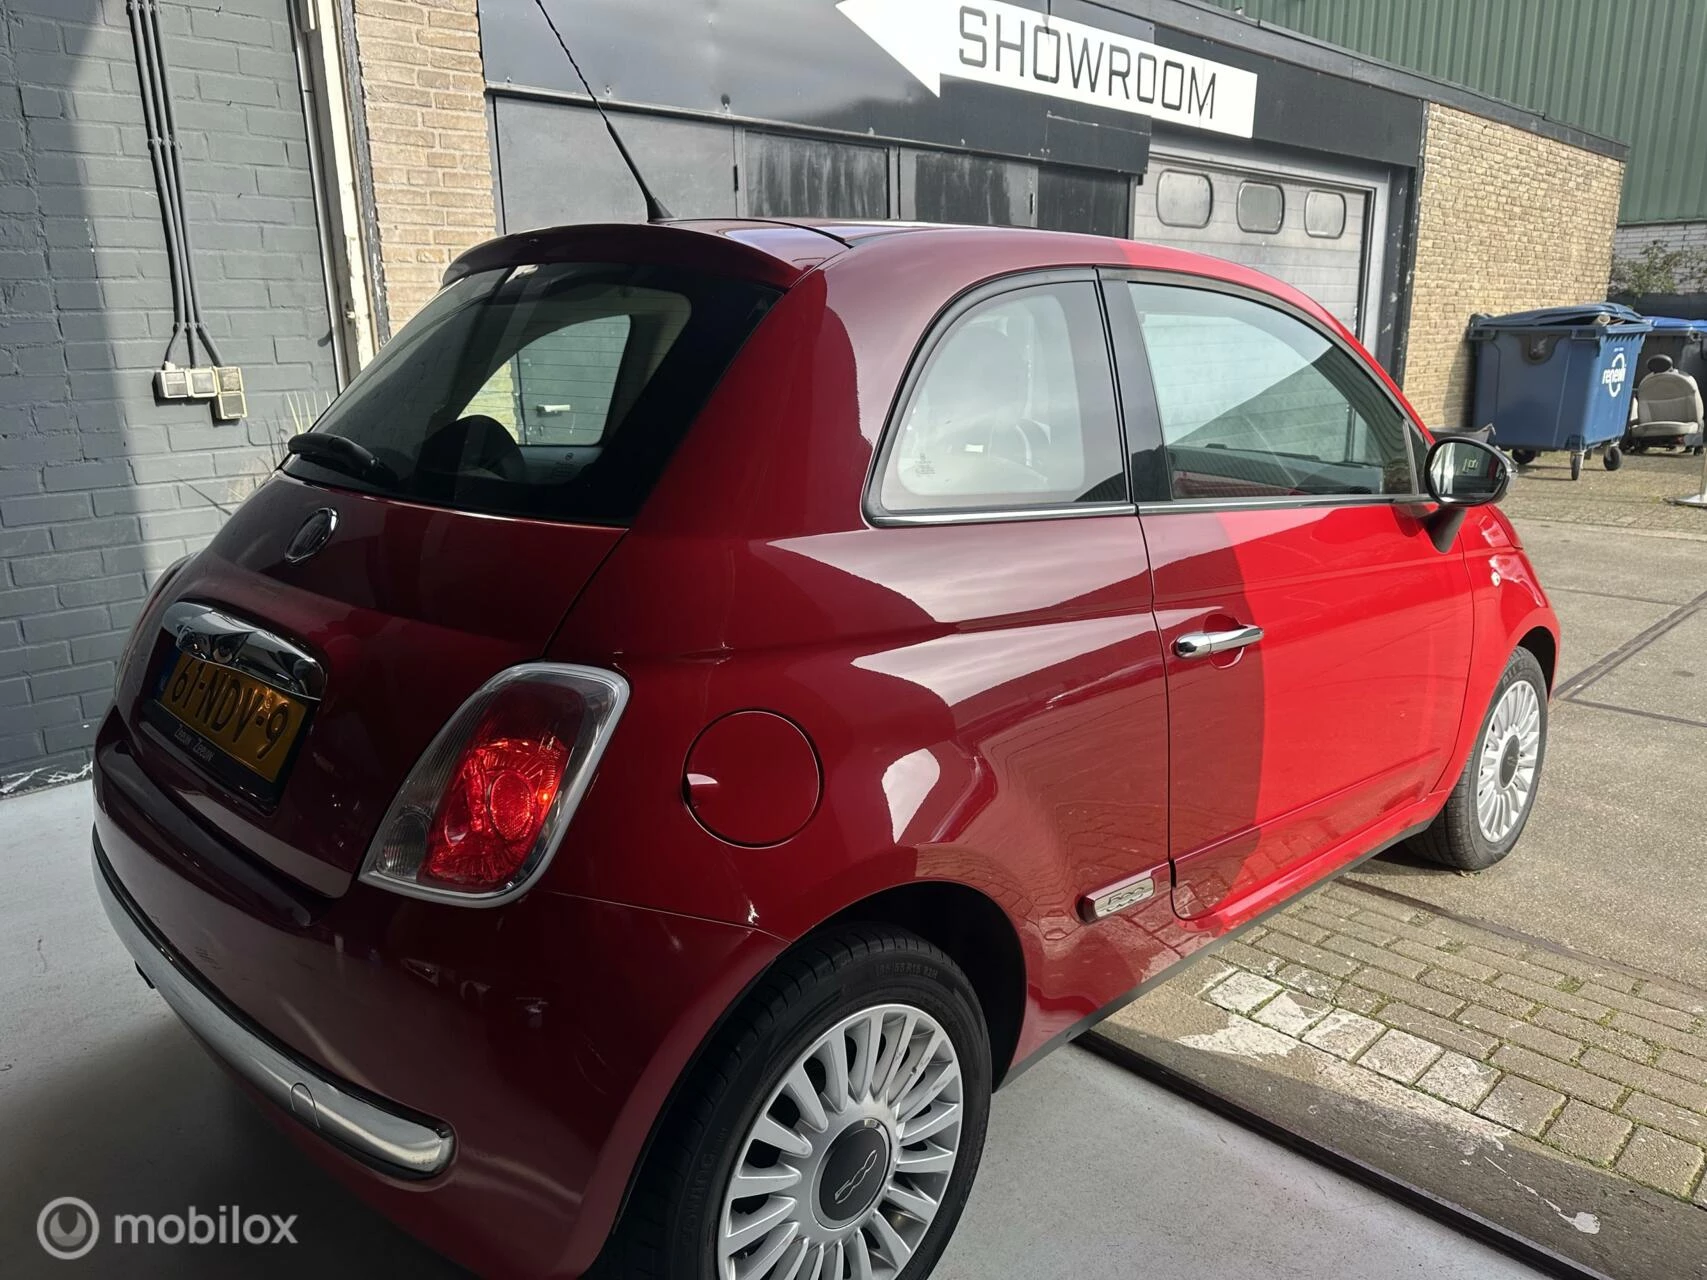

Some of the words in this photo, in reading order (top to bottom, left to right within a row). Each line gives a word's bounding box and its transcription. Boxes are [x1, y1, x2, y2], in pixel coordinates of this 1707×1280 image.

[959, 5, 1217, 120] SHOWROOM
[172, 657, 289, 760] 61-NDV-9
[1107, 887, 1145, 912] 500
